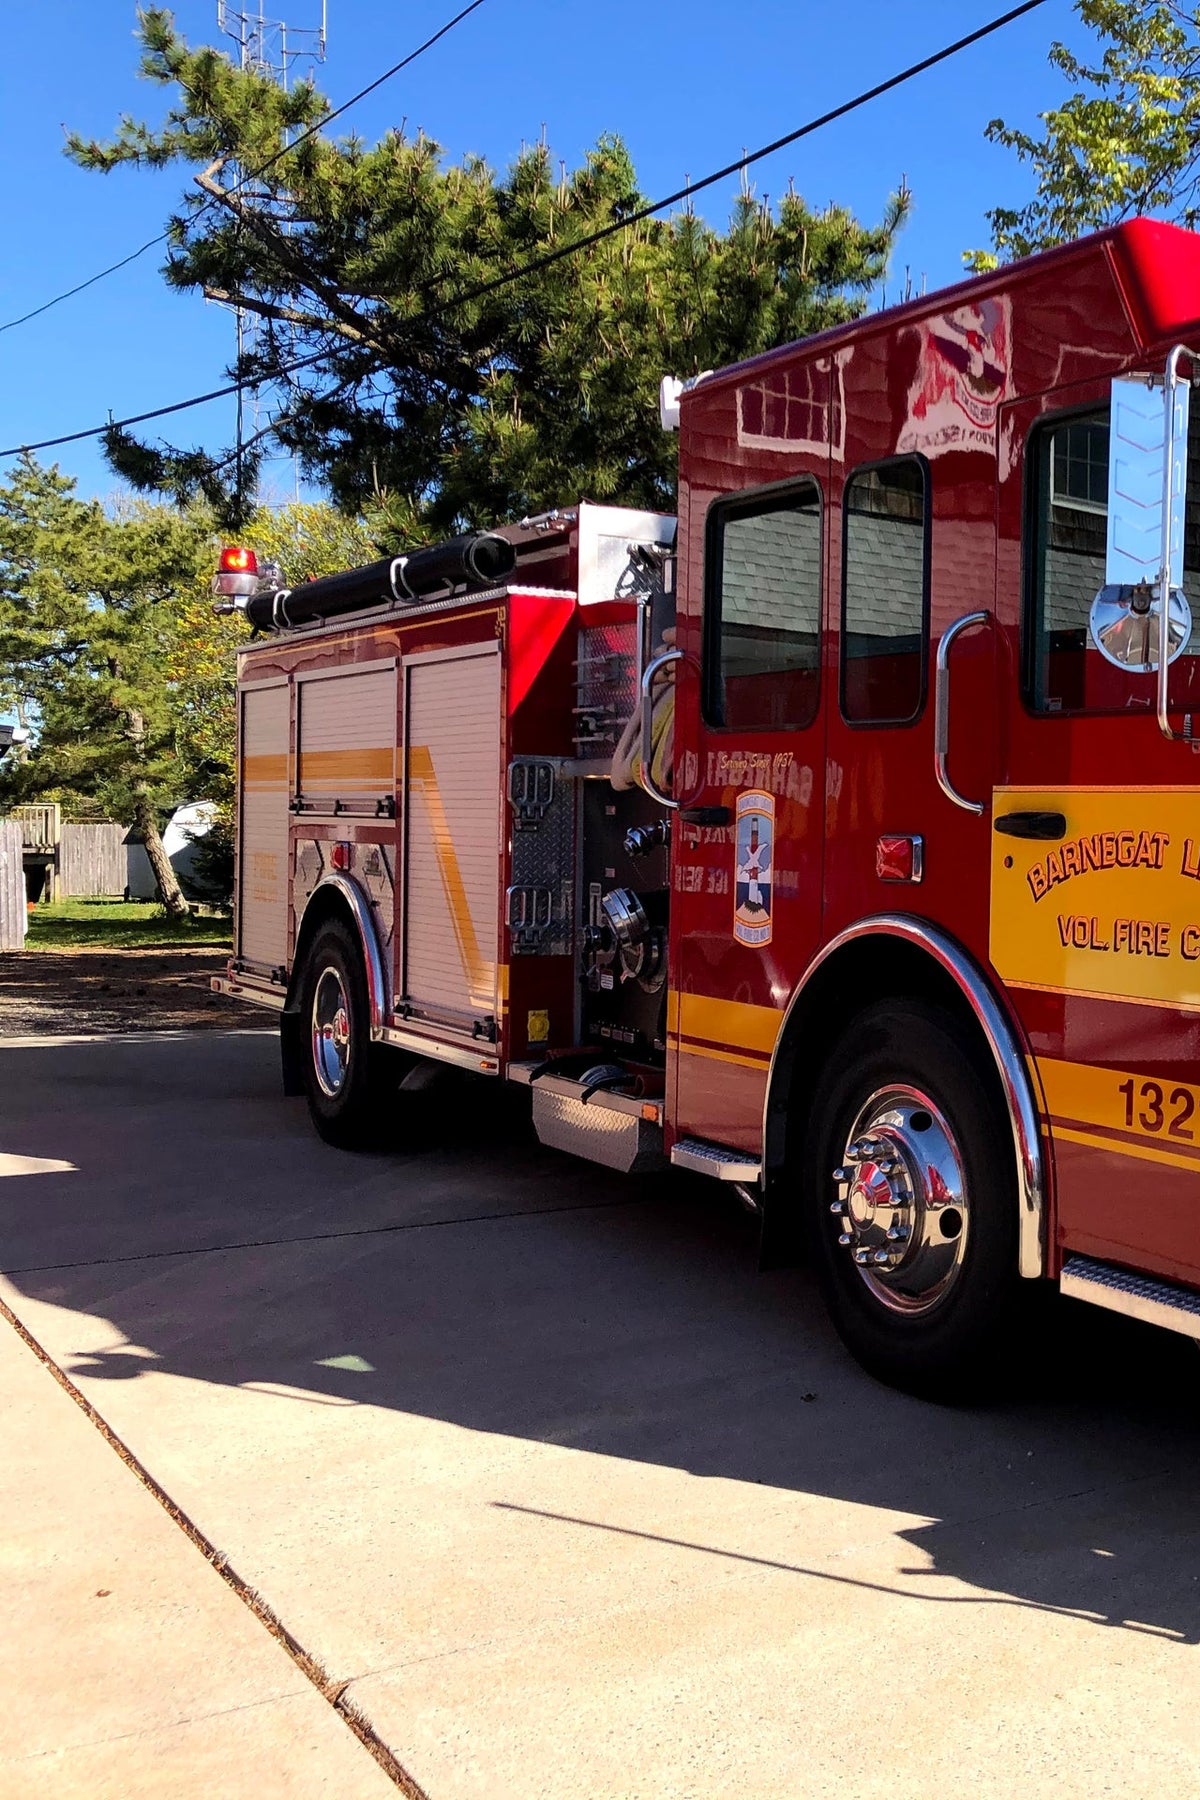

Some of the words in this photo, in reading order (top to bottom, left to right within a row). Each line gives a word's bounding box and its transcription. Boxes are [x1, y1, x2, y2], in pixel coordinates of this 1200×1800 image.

[773, 752, 793, 768] 1937
[1027, 830, 1169, 903] BARNEGAT
[1058, 915, 1110, 951] VOL.
[1114, 918, 1171, 957] FIRE
